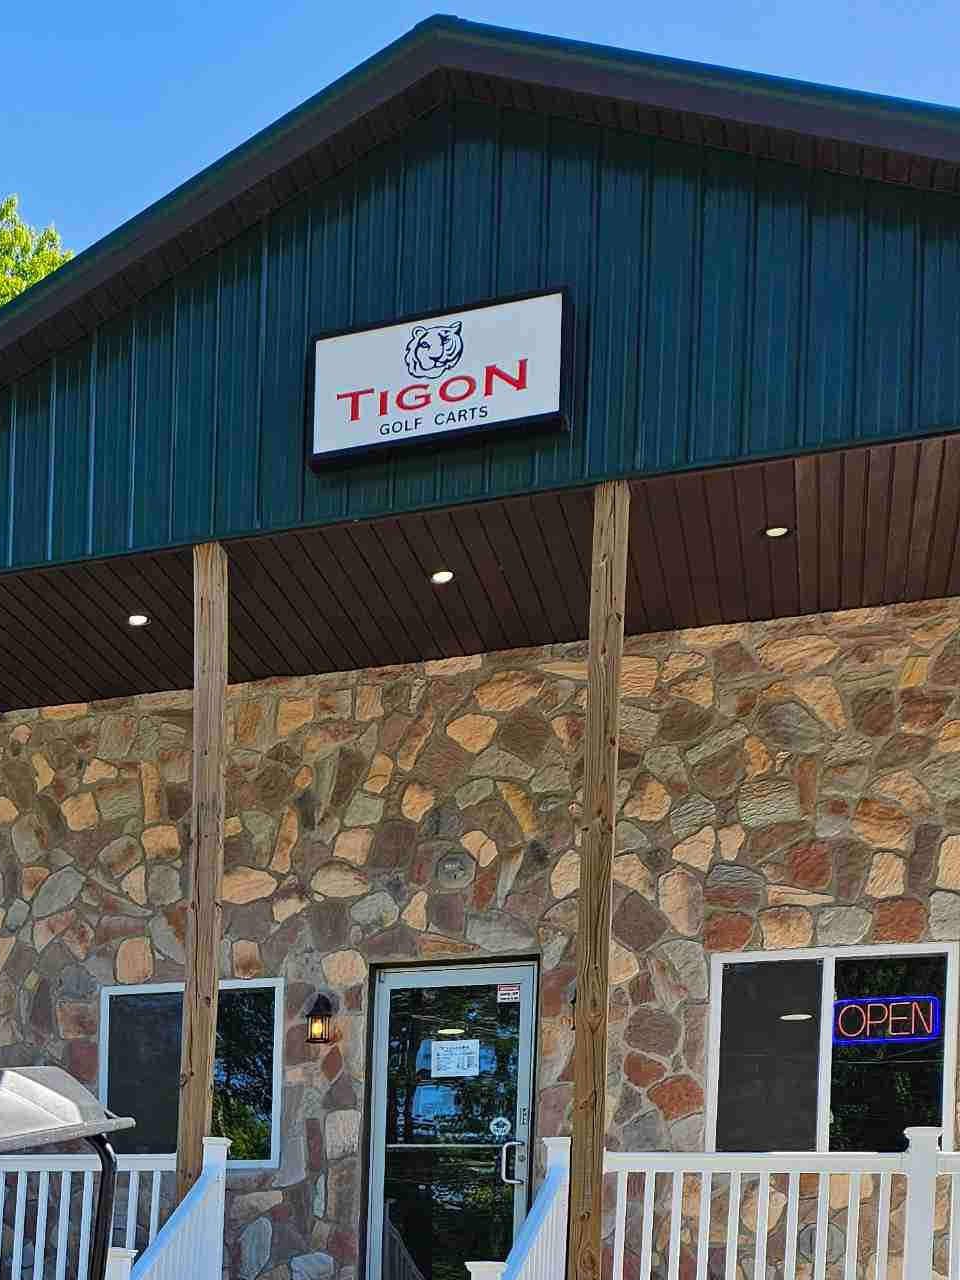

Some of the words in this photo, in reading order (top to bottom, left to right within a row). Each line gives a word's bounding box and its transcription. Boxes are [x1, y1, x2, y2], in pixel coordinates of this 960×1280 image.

[336, 358, 529, 421] TIGON
[379, 417, 423, 435] GOLF
[434, 406, 488, 426] CARTS
[838, 1000, 933, 1037] OPEN
